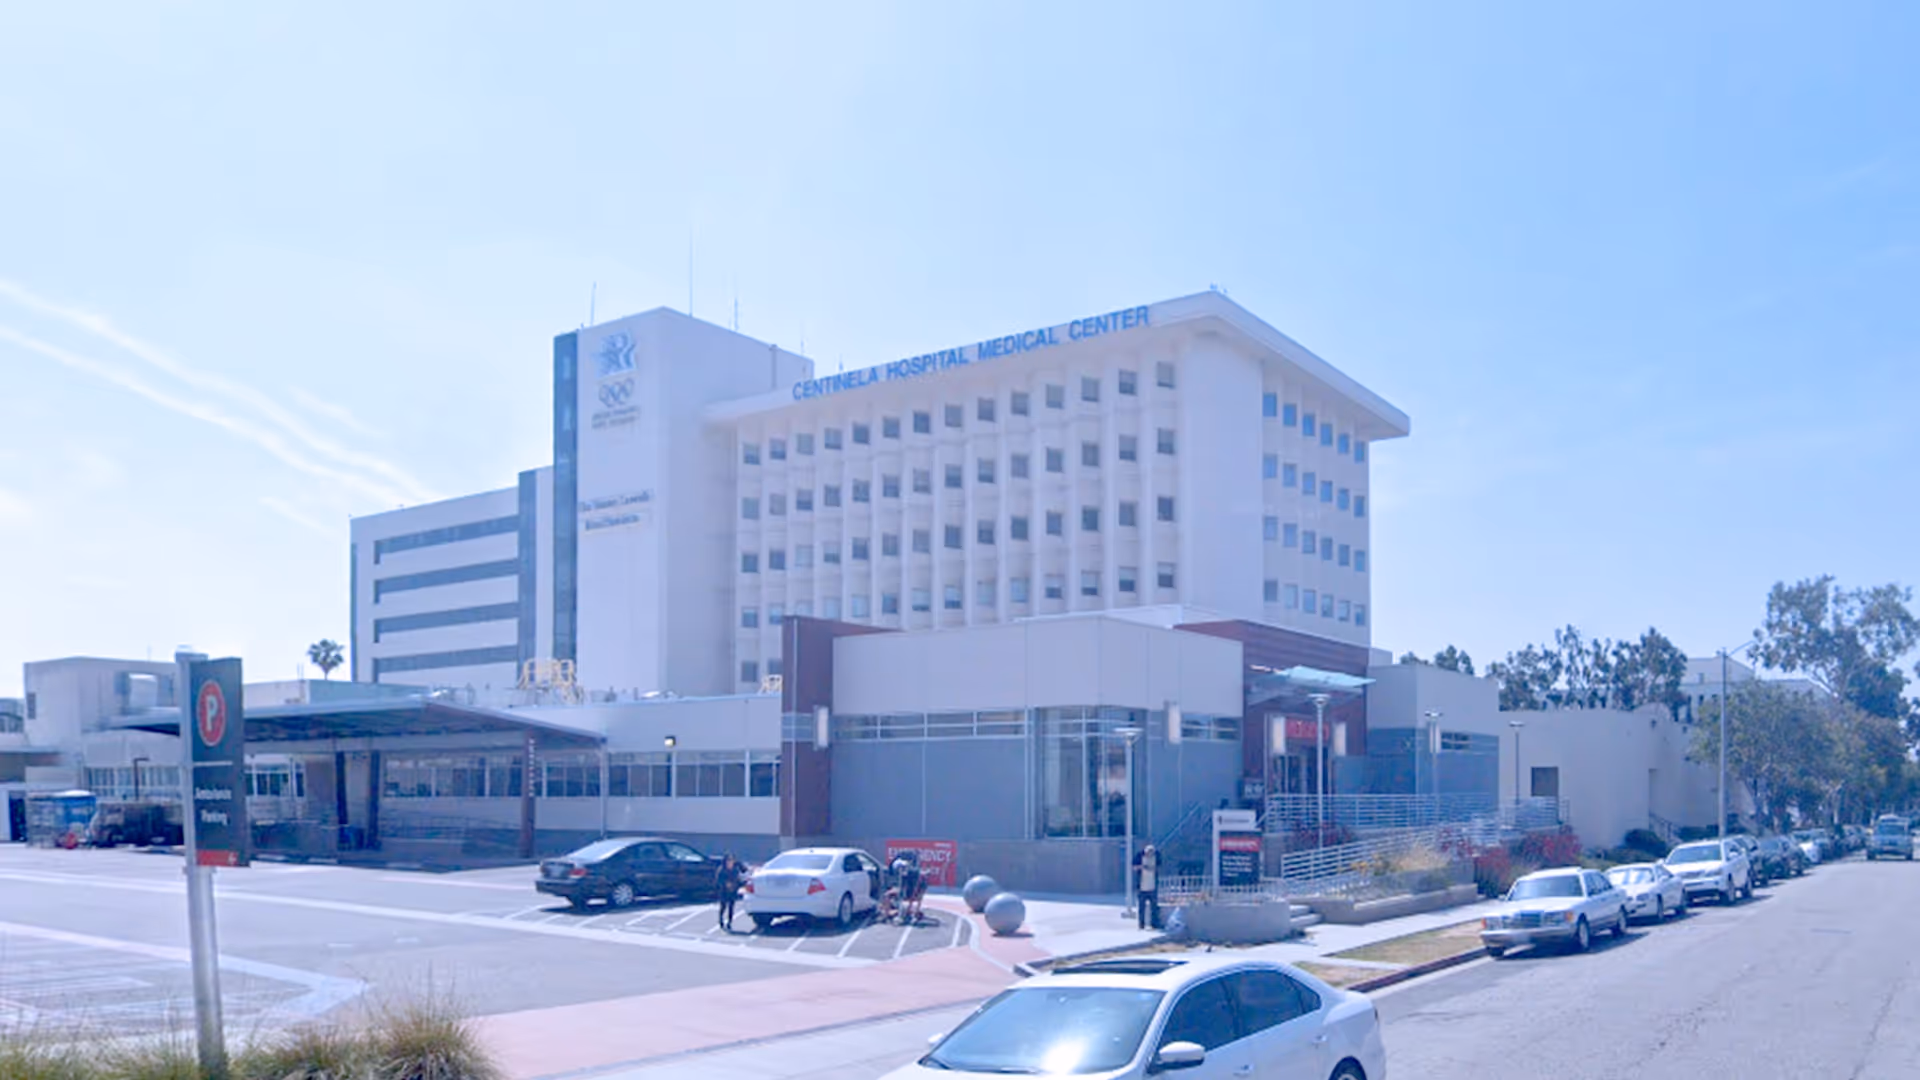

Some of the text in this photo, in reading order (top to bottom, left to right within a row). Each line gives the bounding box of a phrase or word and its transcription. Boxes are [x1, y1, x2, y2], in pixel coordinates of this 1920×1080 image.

[793, 305, 1149, 401] CENTINELA HOSPITAL MEDICAL CENTER
[205, 694, 219, 732] P
[888, 847, 952, 863] EMENCY
